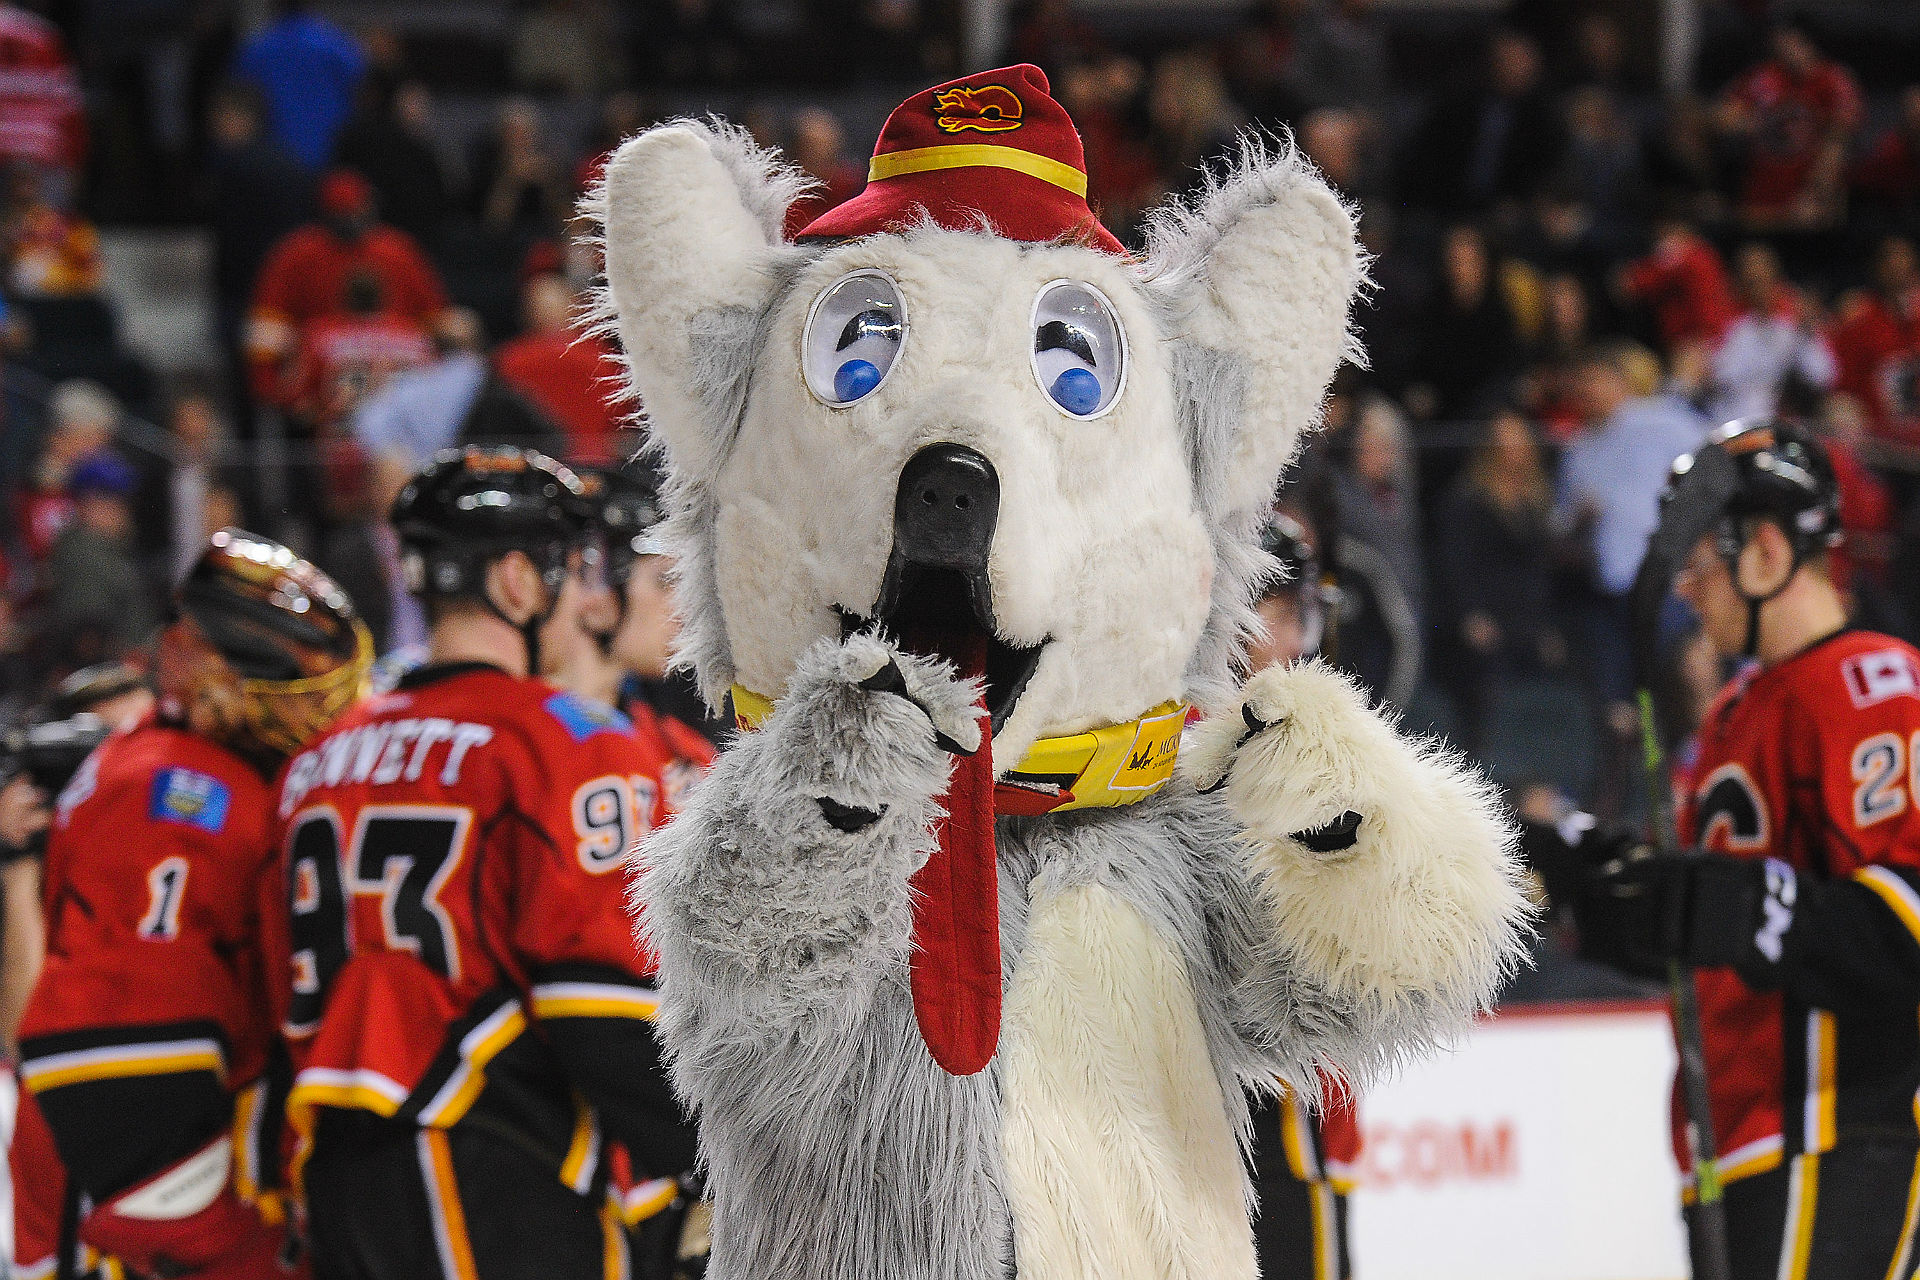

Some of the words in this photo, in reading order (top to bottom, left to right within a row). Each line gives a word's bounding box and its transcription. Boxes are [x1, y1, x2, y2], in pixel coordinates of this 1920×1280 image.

[1851, 728, 1920, 829] 2
[137, 855, 190, 943] 1
[279, 804, 474, 1040] 97
